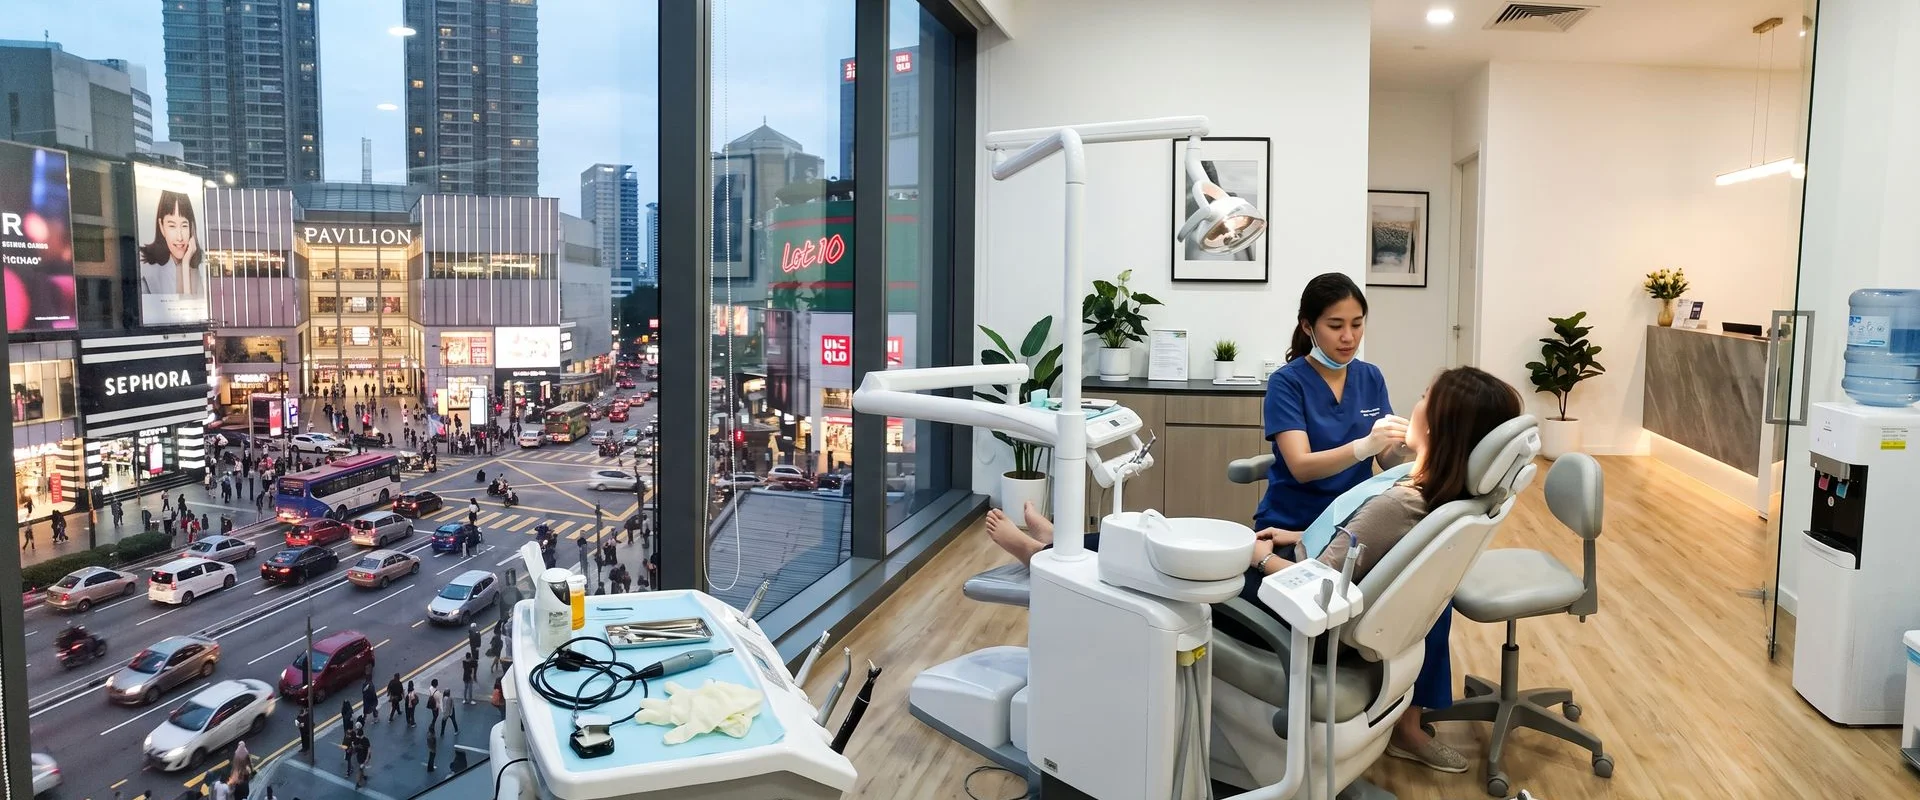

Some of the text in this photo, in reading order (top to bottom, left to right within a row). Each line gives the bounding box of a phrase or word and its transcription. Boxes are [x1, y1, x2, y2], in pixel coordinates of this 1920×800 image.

[2, 212, 23, 236] R
[304, 227, 412, 245] PAVILION
[782, 234, 845, 273] Lot 10
[104, 369, 191, 396] SEPHORA
